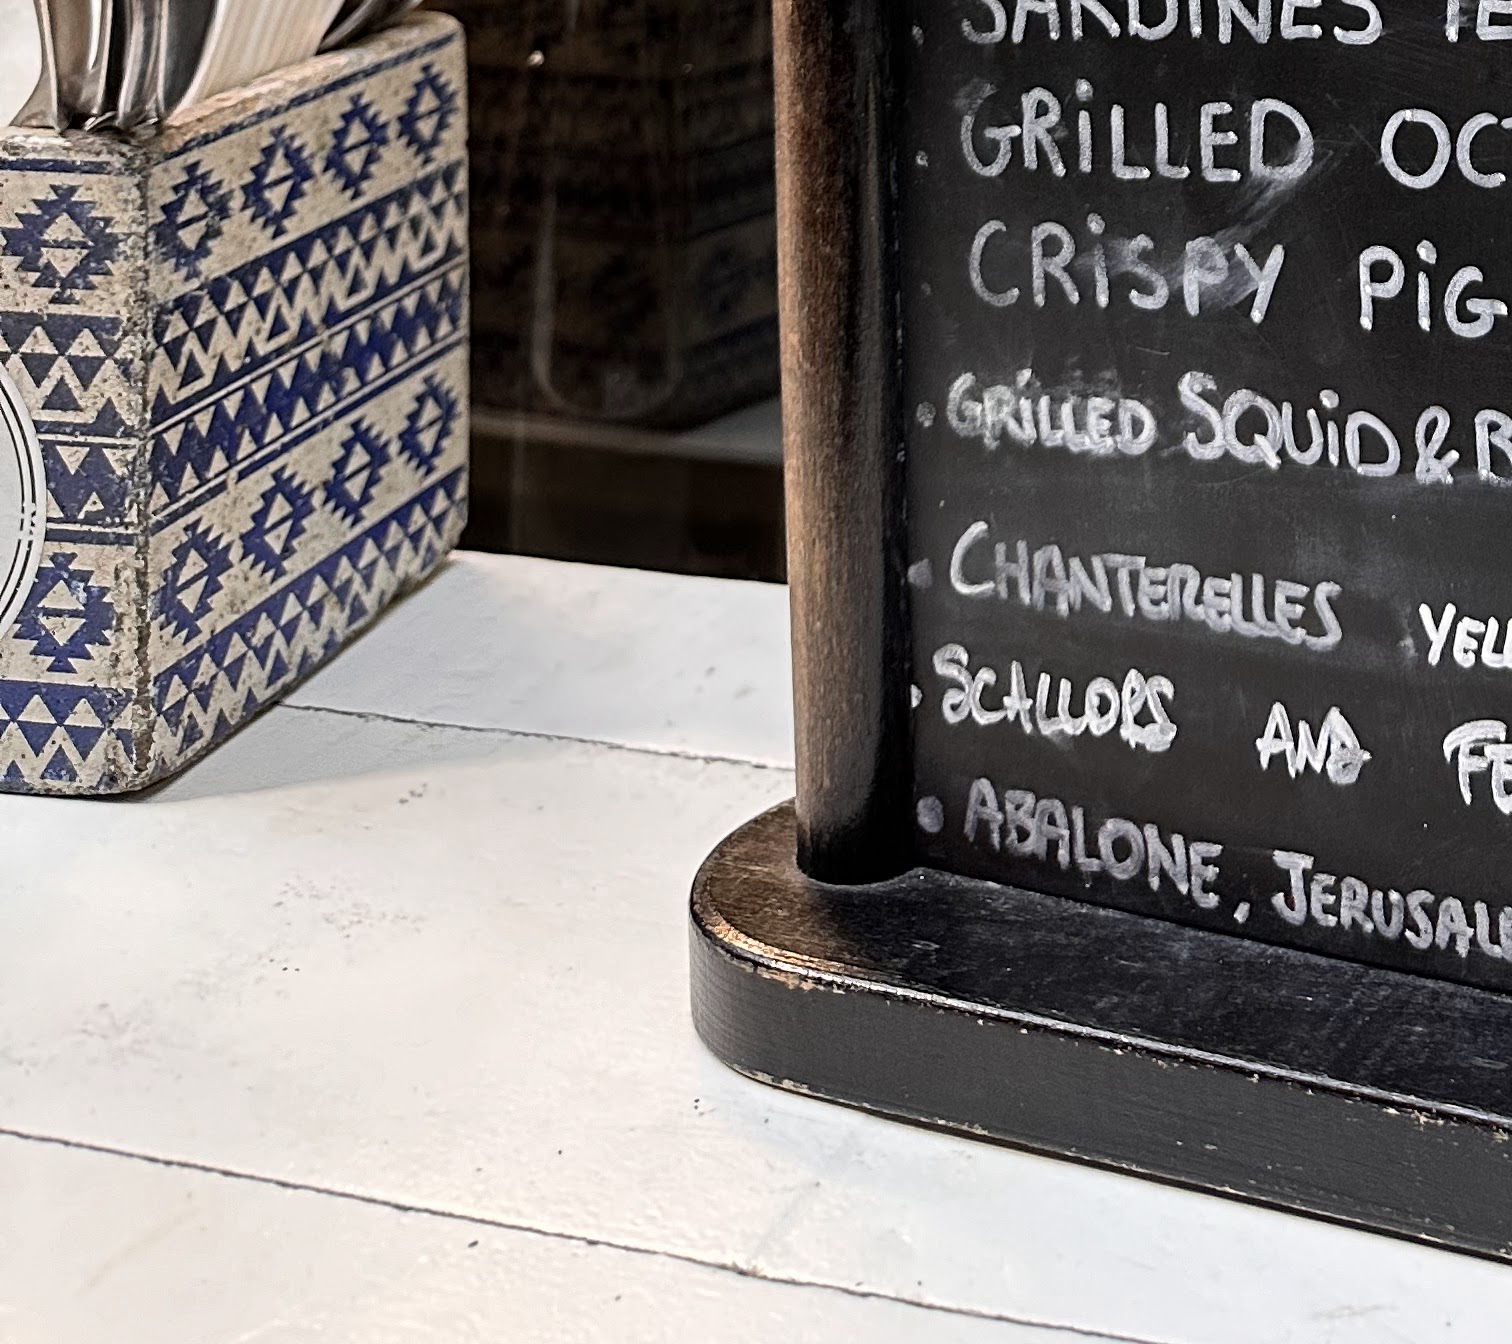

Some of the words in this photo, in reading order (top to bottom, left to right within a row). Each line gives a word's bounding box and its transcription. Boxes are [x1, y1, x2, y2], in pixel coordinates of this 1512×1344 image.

[1415, 404, 1462, 485] &
[949, 520, 1344, 653] CHANTERELLES
[1255, 701, 1374, 786] AND
